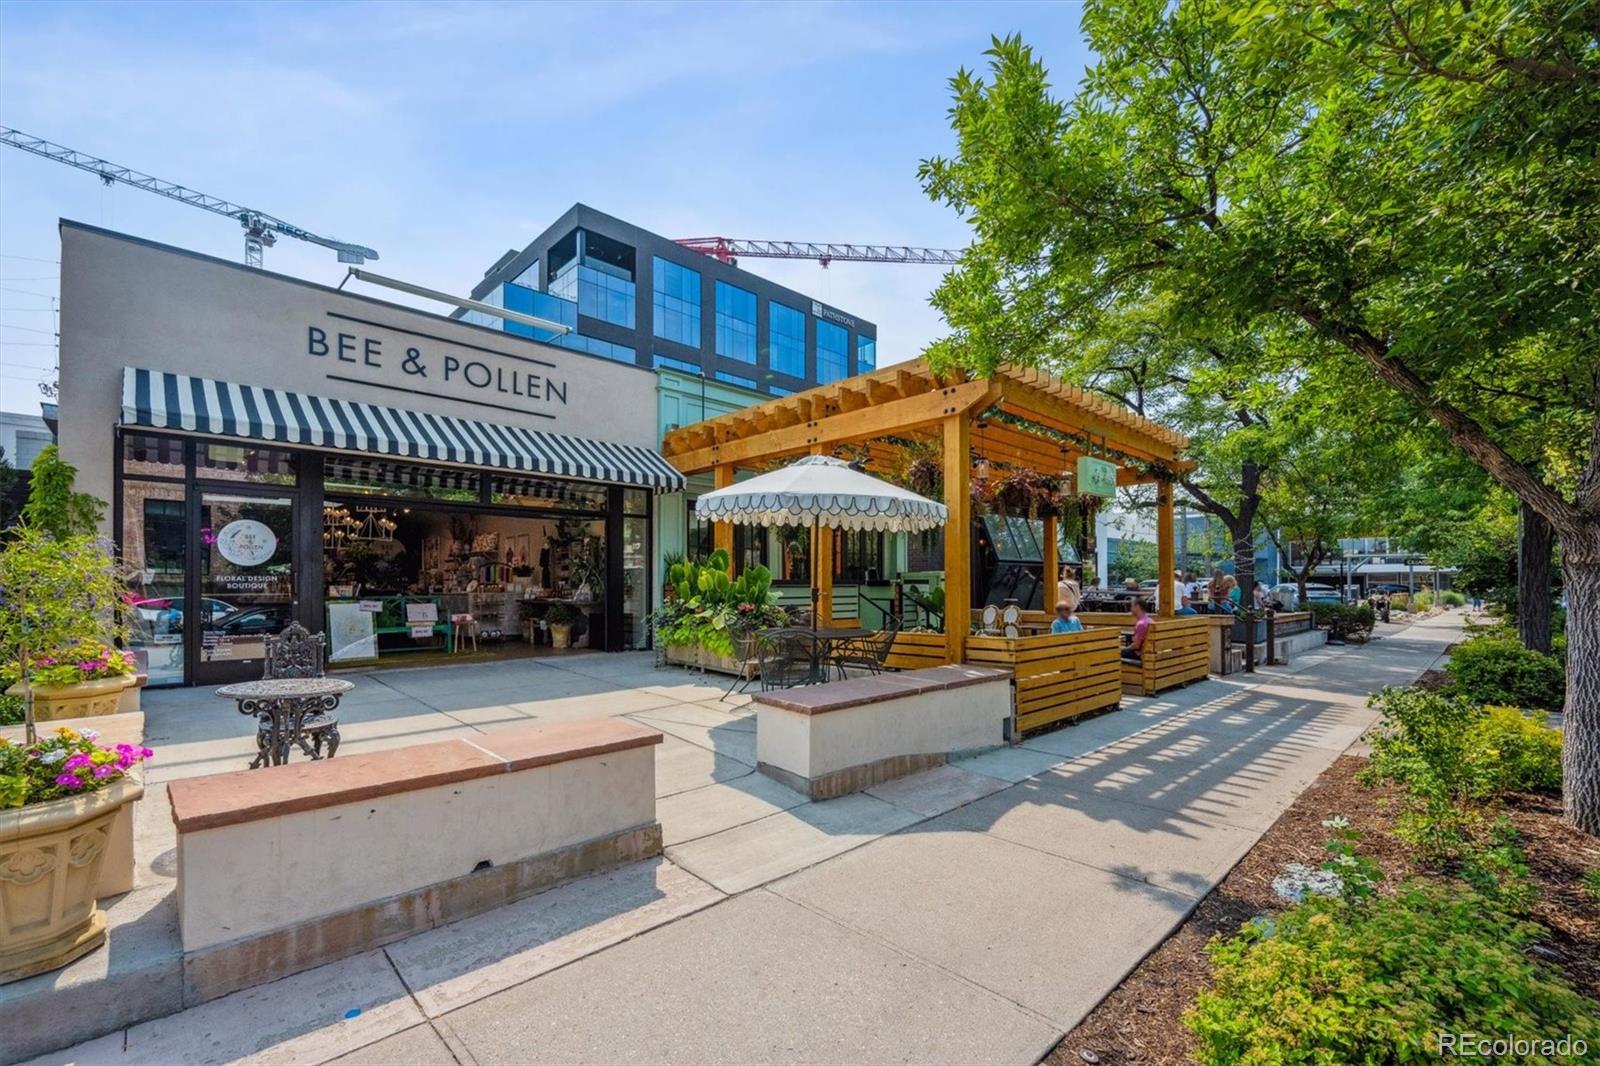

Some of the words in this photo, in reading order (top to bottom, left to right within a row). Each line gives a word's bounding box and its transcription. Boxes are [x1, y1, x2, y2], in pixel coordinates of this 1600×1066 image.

[308, 326, 382, 368] BEE
[401, 347, 427, 378] &
[444, 355, 567, 405] POLLEN
